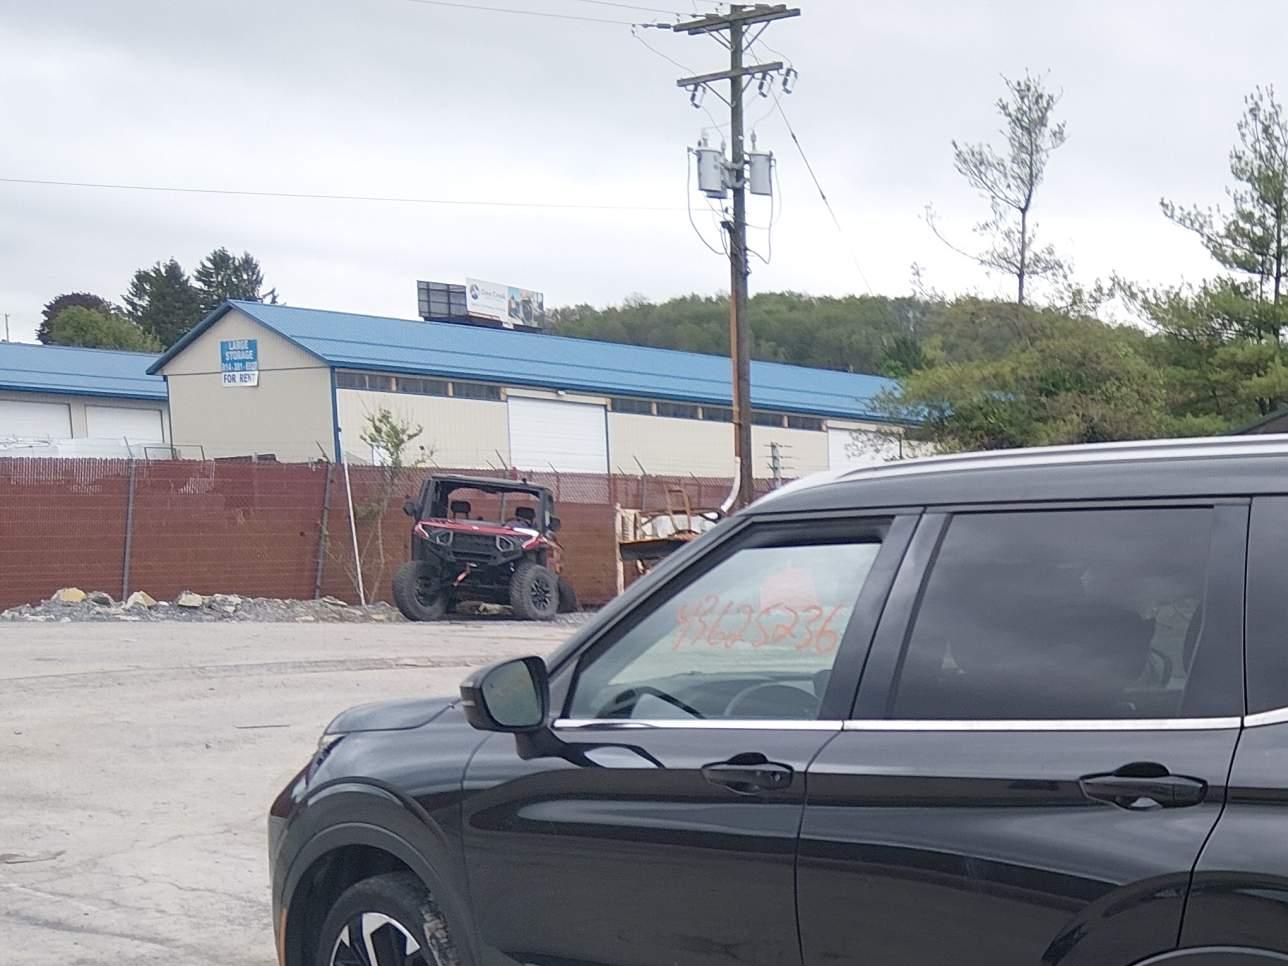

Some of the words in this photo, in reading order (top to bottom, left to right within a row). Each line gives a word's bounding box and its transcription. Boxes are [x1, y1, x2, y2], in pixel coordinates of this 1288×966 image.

[225, 350, 254, 361] STORAGE
[223, 374, 236, 383] FOR
[239, 373, 256, 383] RENT
